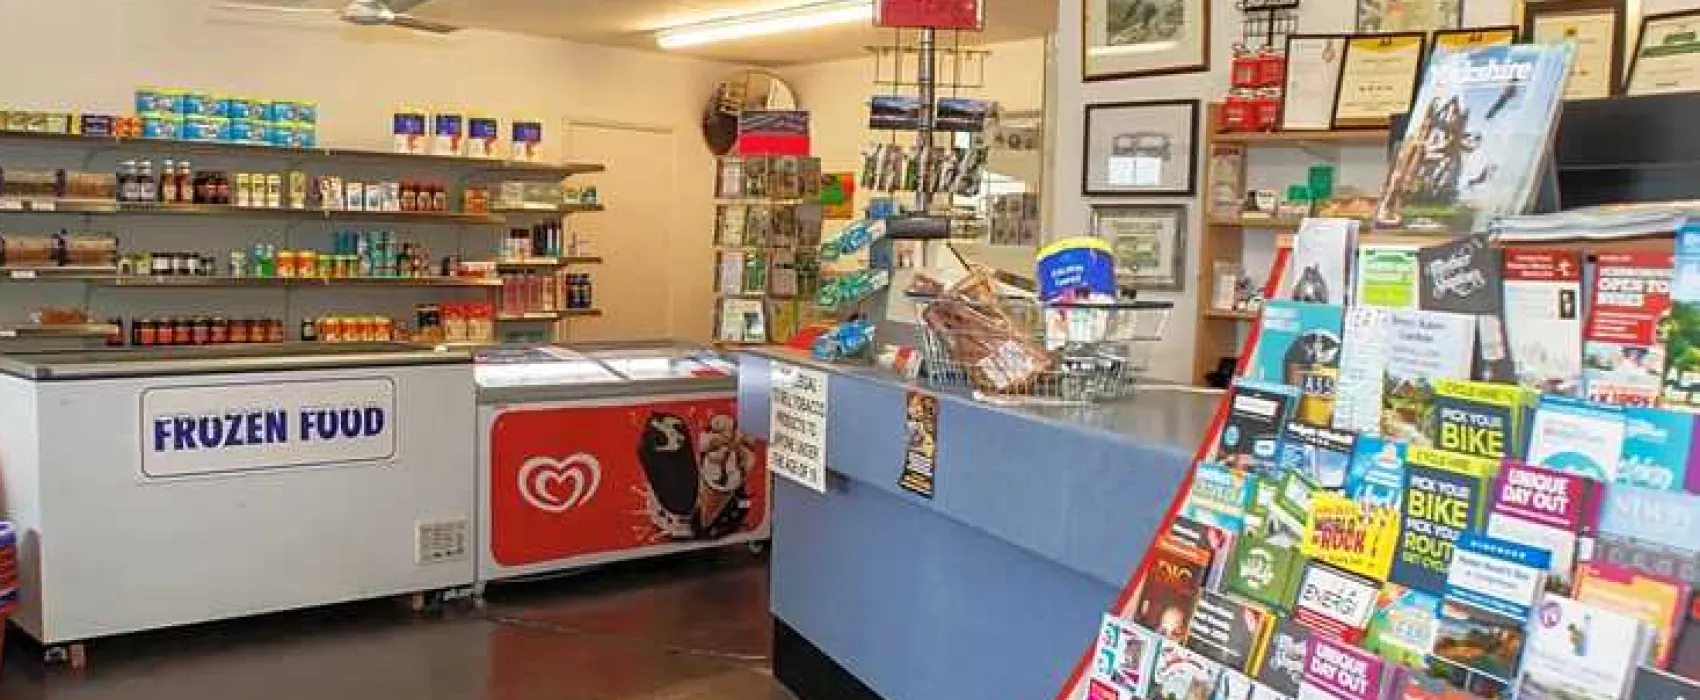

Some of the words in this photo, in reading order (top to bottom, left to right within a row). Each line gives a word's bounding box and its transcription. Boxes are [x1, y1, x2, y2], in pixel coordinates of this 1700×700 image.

[154, 408, 288, 452] FROZEN
[301, 405, 385, 441] FOOD
[1441, 422, 1505, 457] BIKE
[1508, 467, 1568, 496] UNIQUE
[1408, 489, 1469, 529] BIKE
[1501, 484, 1531, 506] DAY
[1533, 490, 1567, 515] OUT
[1403, 531, 1452, 562] ROUT
[1316, 643, 1367, 674] UNIQUE
[1309, 656, 1339, 680] DAY
[1337, 666, 1368, 696] OUT
